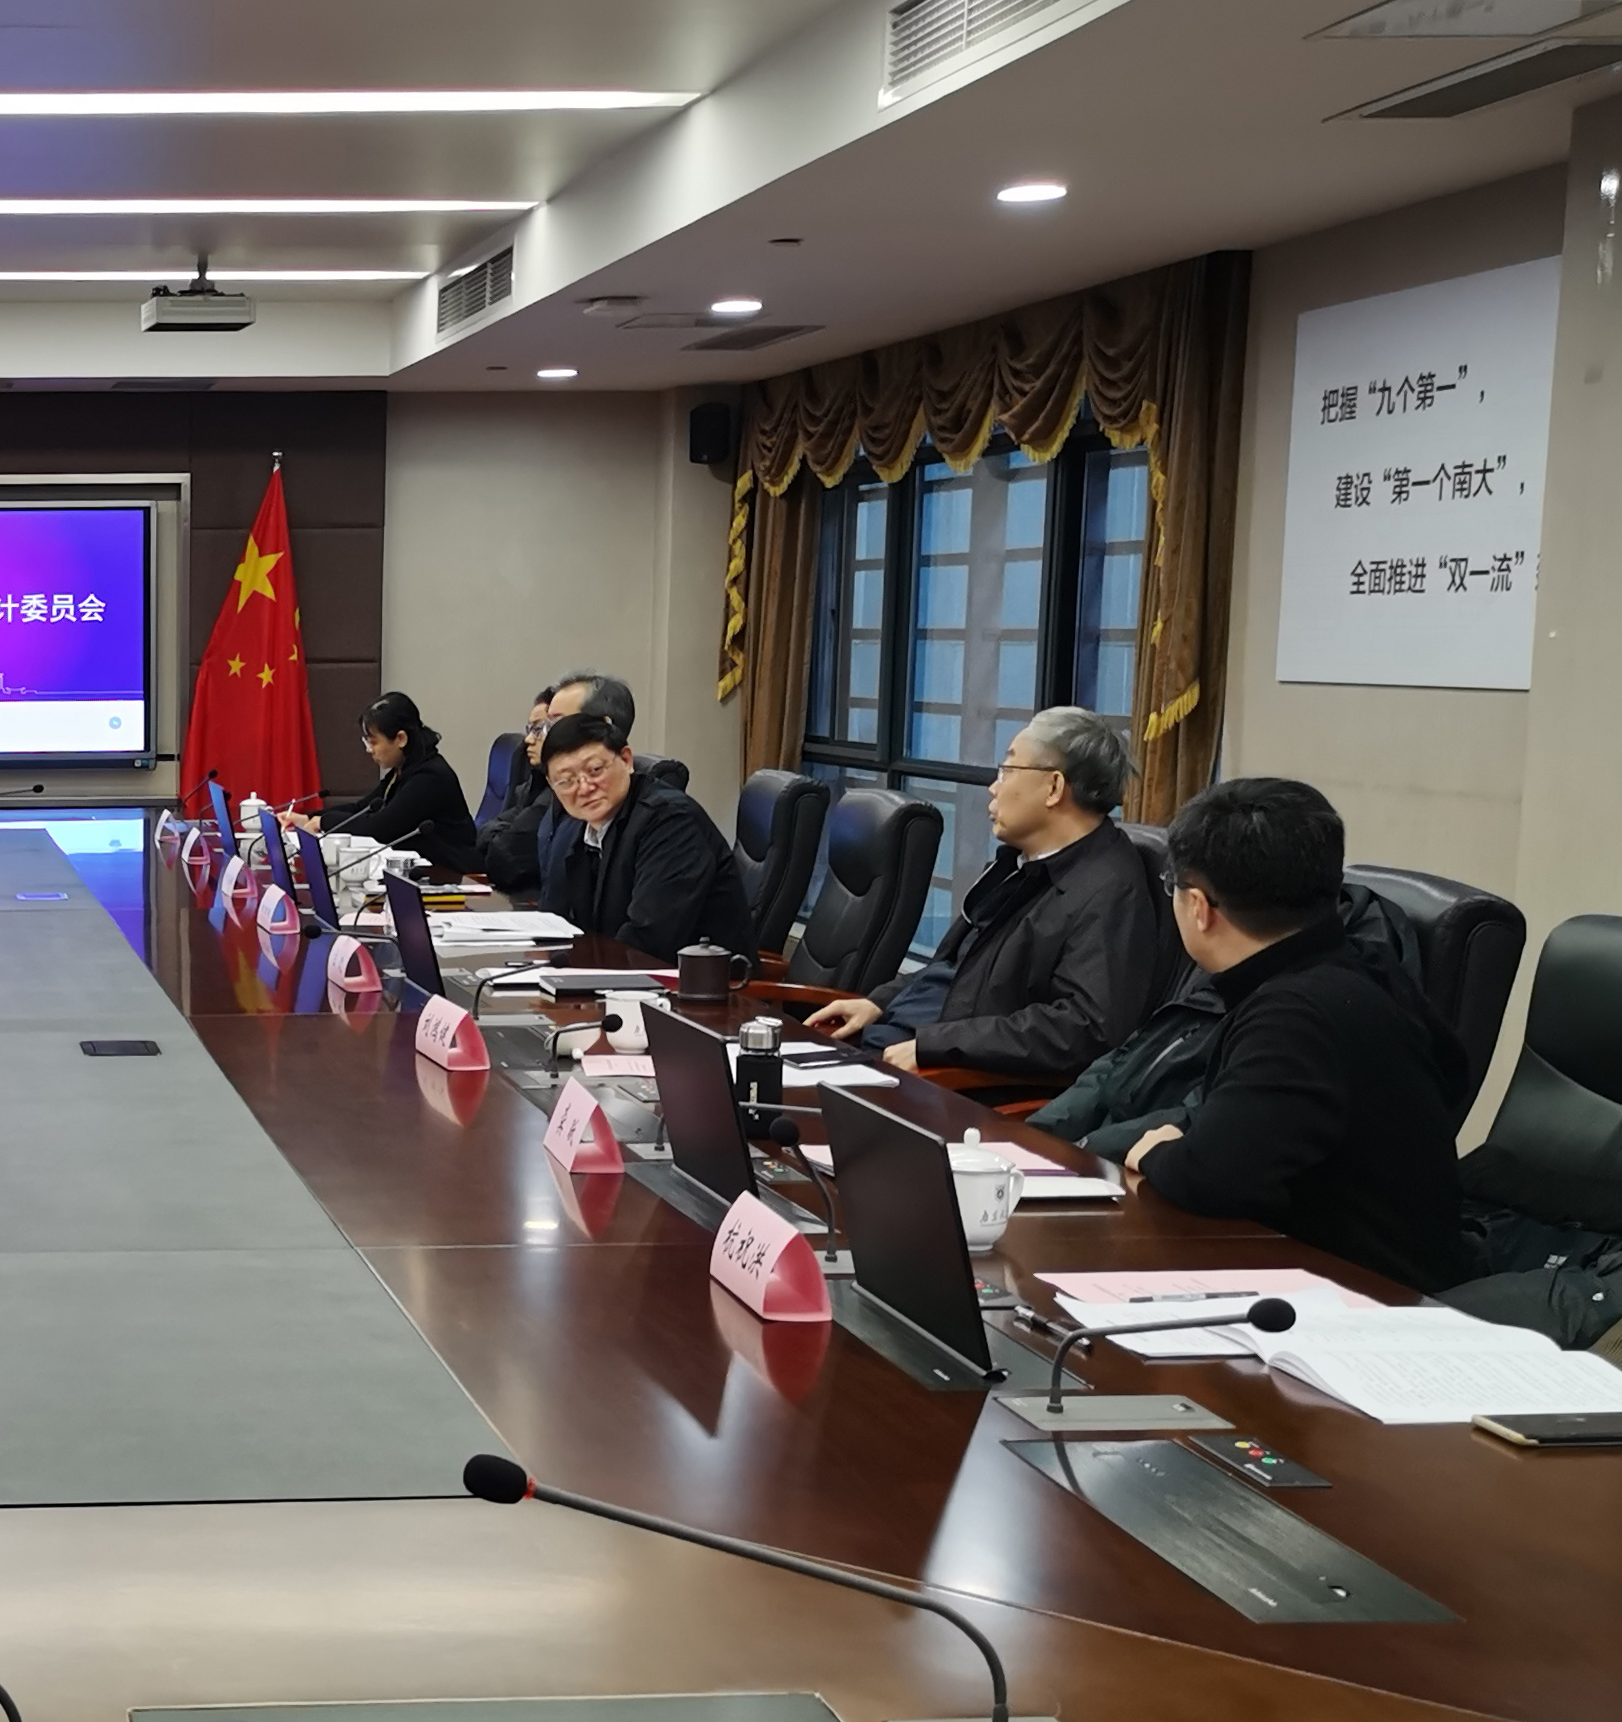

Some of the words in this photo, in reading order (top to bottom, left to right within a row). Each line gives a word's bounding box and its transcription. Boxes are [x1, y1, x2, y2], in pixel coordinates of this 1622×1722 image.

[1349, 551, 1541, 595] 全面推进“双一流”
